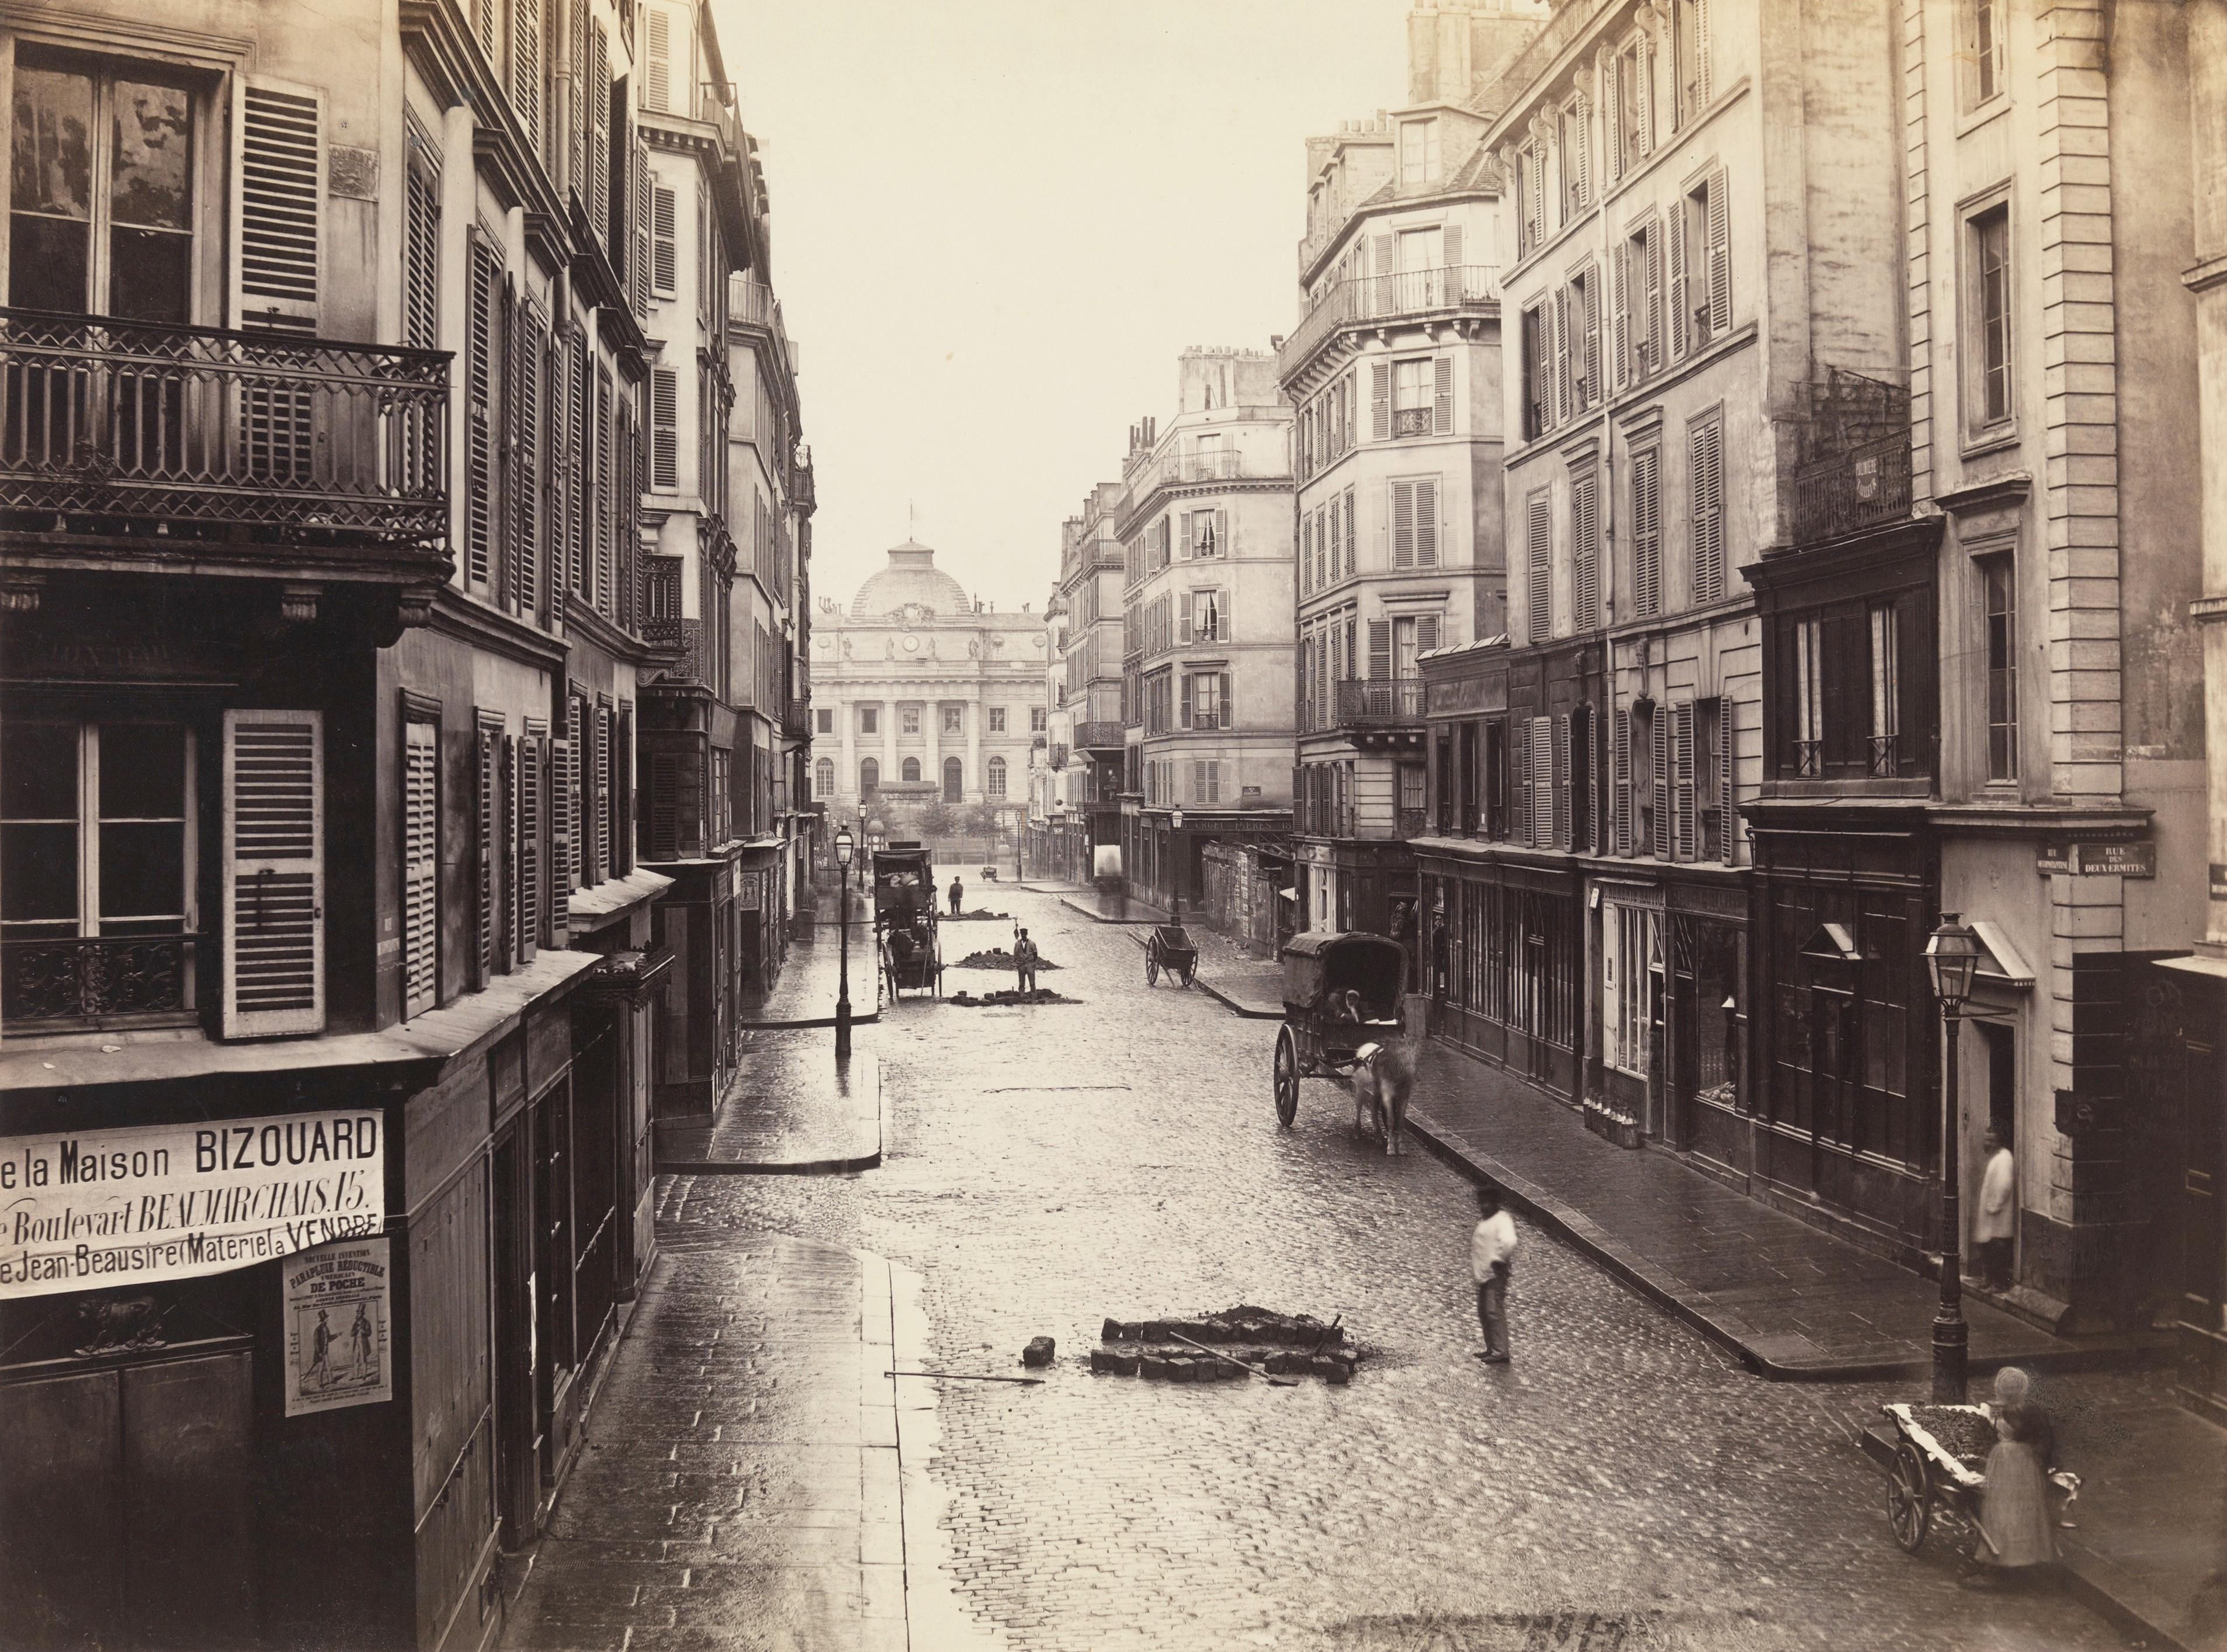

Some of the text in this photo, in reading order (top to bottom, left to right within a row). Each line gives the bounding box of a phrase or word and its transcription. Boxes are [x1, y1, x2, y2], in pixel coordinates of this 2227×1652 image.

[2047, 848, 2057, 857] RUE
[2105, 847, 2125, 856] RUE
[25, 1148, 48, 1188] la
[60, 1140, 169, 1185] Maison
[196, 1116, 377, 1173] BIZOUARD
[11, 1200, 134, 1245] Boulevart
[304, 1249, 370, 1264] NOUVELLE INVENTION
[289, 1259, 386, 1290] PARAPLUIE RÉDUCTIBLE
[310, 1276, 365, 1293] DE POCHE
